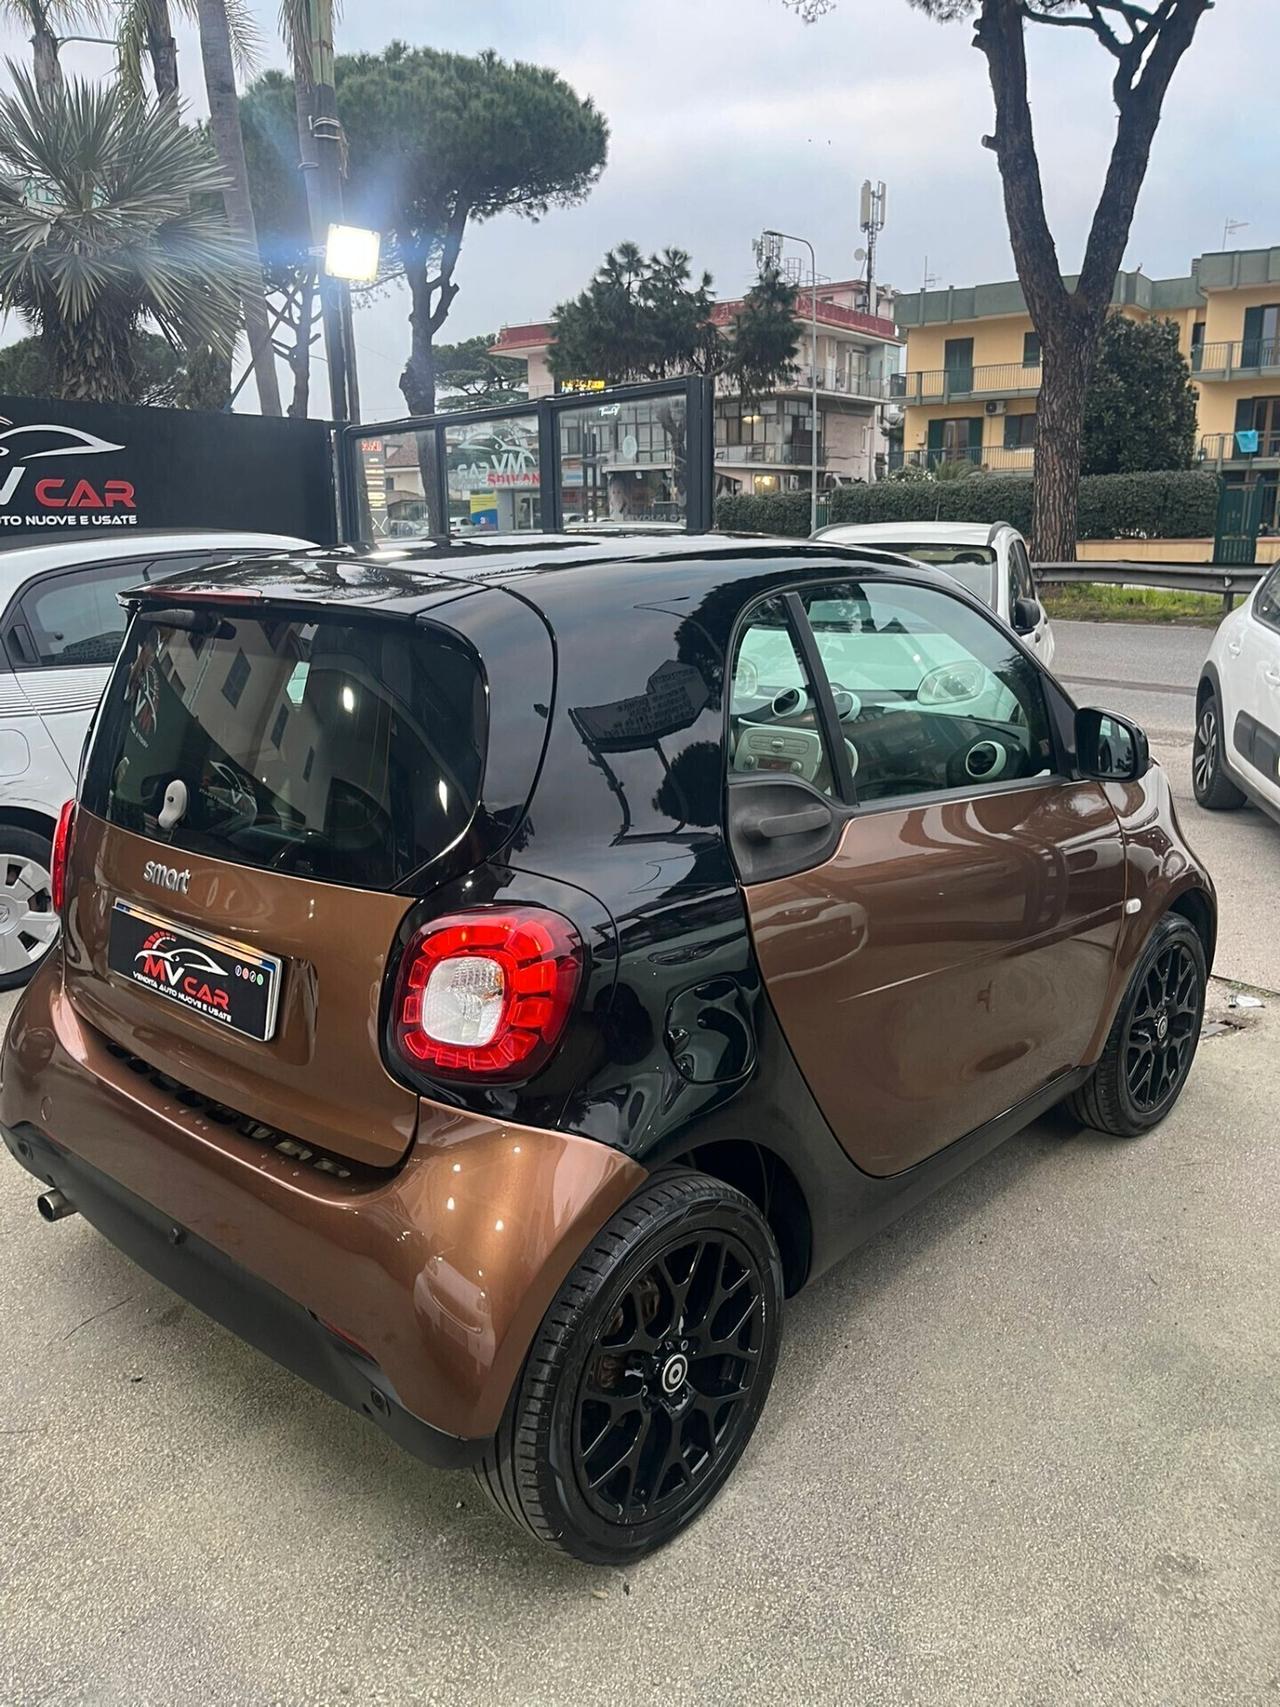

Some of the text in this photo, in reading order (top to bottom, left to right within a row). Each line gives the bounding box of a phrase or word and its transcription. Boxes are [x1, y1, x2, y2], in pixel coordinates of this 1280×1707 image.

[34, 478, 137, 508] CAR
[0, 515, 138, 526] TO NUOVE E USATE
[143, 860, 192, 895] smart
[132, 970, 232, 1023] VENDITA AUTO NUOVE E USATE
[143, 954, 230, 1011] MV CAR
